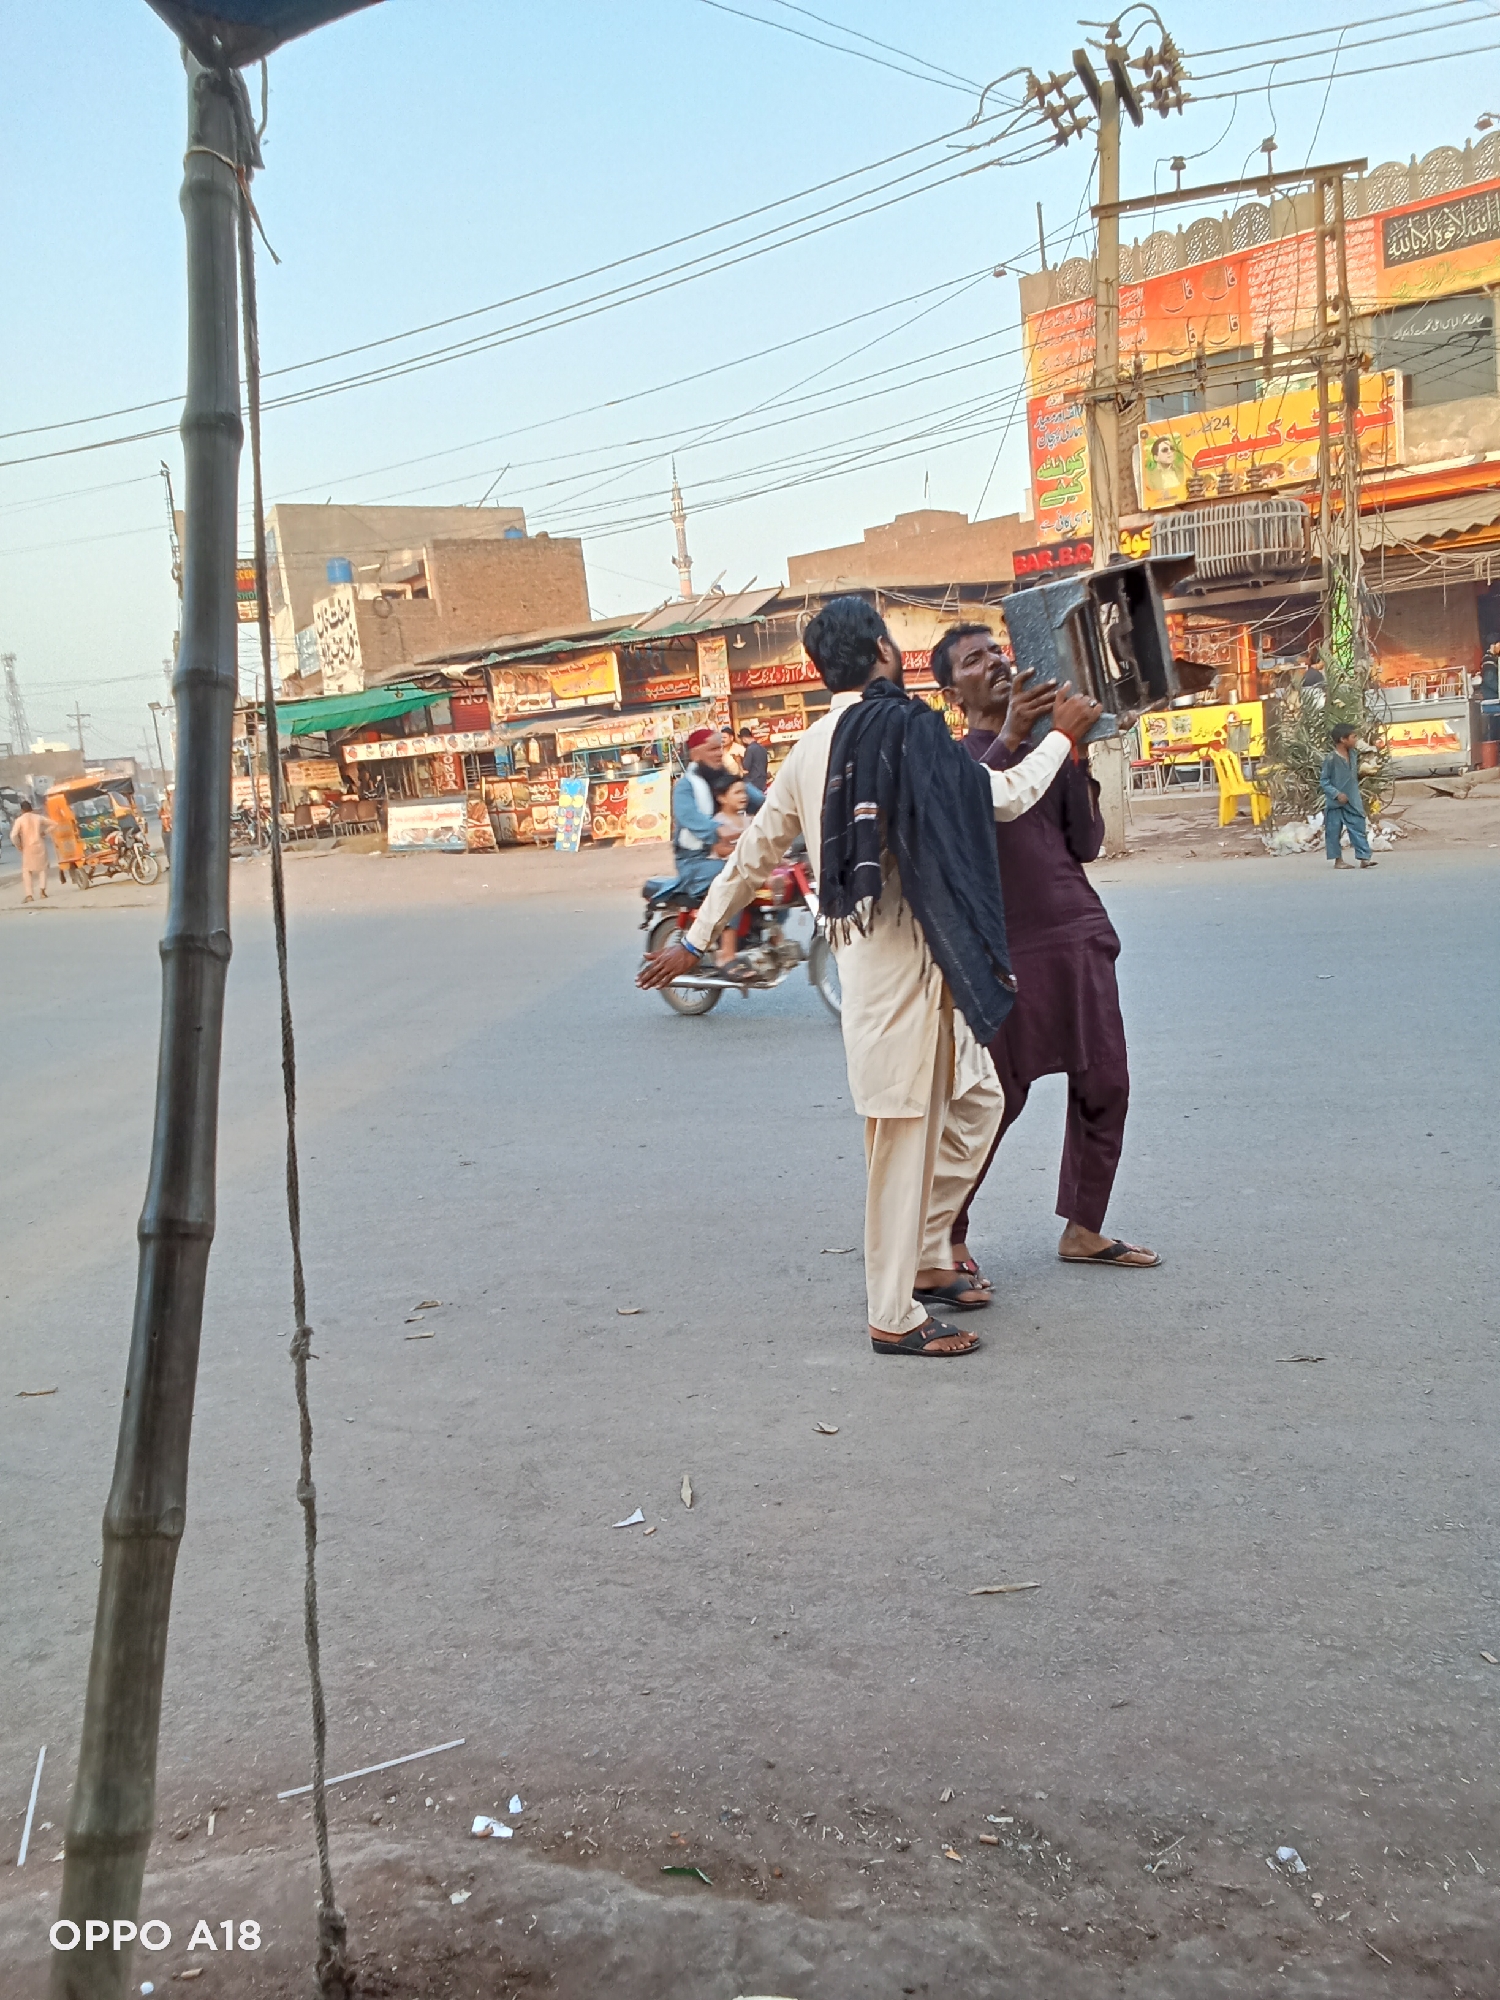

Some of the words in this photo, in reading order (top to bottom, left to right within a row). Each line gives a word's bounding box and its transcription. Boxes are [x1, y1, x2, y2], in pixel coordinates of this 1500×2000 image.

[1213, 414, 1231, 431] 24
[1191, 418, 1284, 470] کیفے
[442, 755, 459, 790] ONDA
